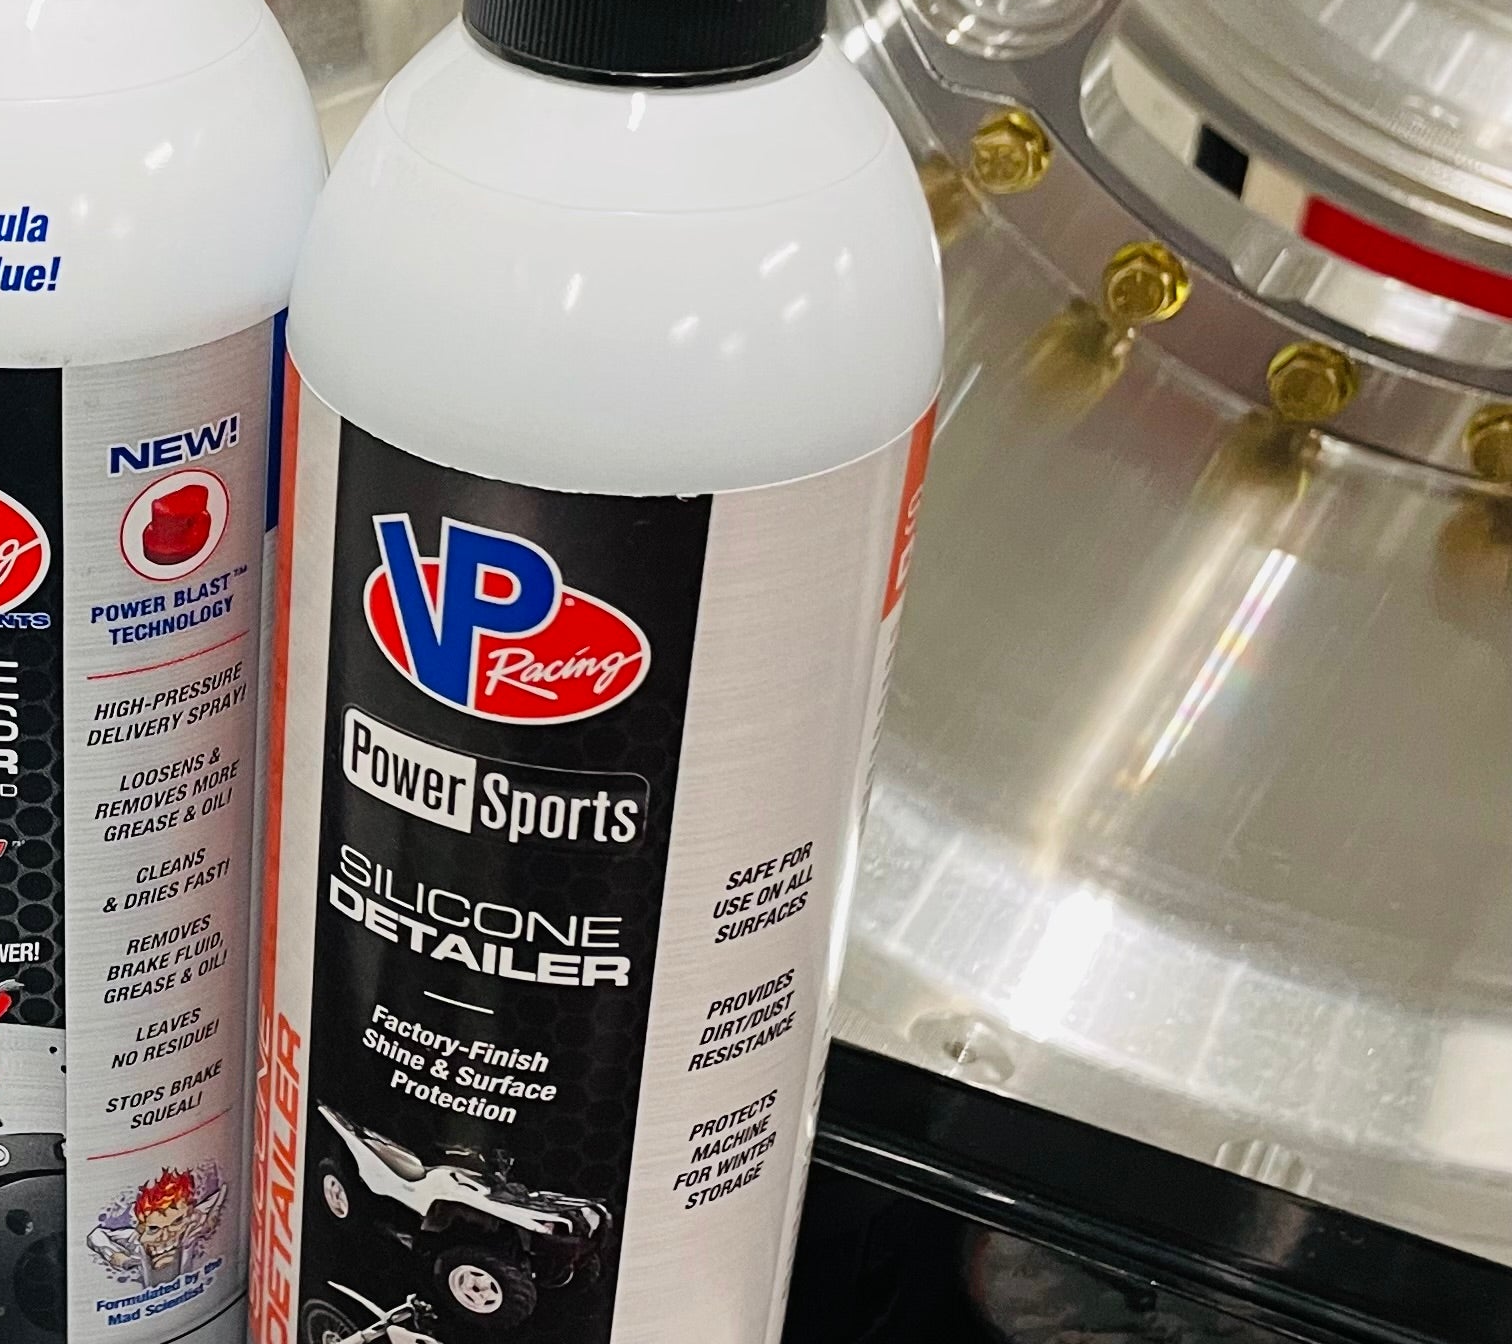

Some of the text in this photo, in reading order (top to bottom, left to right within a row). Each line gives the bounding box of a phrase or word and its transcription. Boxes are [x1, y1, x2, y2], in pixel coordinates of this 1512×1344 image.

[109, 416, 237, 474] NEW!
[90, 595, 165, 624] POWER
[109, 594, 234, 646] TECHNOLOGY
[376, 516, 643, 708] VP Racing
[87, 683, 247, 747] DELIVERY SPRAY!
[94, 661, 243, 721] HIGH-PRESSURE
[95, 759, 240, 820] REMOVES MORE
[119, 747, 221, 792] LOOSENS &
[351, 718, 639, 843] Power Sports
[104, 788, 233, 842] GREASE & OIL!
[103, 858, 231, 913] & DRIES FAST!
[137, 847, 206, 884] CLEANS
[713, 864, 813, 919] USE ON ALL
[725, 841, 813, 891] SAFE FOR
[339, 844, 623, 948] SILICONE
[714, 892, 809, 944] SURFACES
[107, 931, 224, 982] BRAKE FLUID,
[126, 914, 212, 956] REMOVES
[329, 874, 631, 987] DETAILER
[103, 971, 177, 1005] GREASE
[180, 966, 192, 985] &
[707, 969, 795, 1020] PROVIDES
[111, 1019, 220, 1069] NO RESIDUE!
[135, 1007, 202, 1042] LEAVES
[372, 1004, 549, 1074] Factory-Finish
[688, 1011, 796, 1073] RESISTANCE
[699, 991, 795, 1046] DIRT/DUST
[105, 1059, 223, 1113] STOPS BRAKE
[362, 1029, 557, 1103] Shine & Surface
[130, 1091, 203, 1129] SQUEAL!
[390, 1069, 517, 1124] Protection
[688, 1089, 778, 1142] PROTECTS
[673, 1131, 777, 1191] FOR WINTER
[691, 1114, 771, 1164] MACHINE
[685, 1161, 765, 1210] STORAGE
[96, 1257, 223, 1312] Formulated by the
[108, 1283, 205, 1326] Mad Scientist
